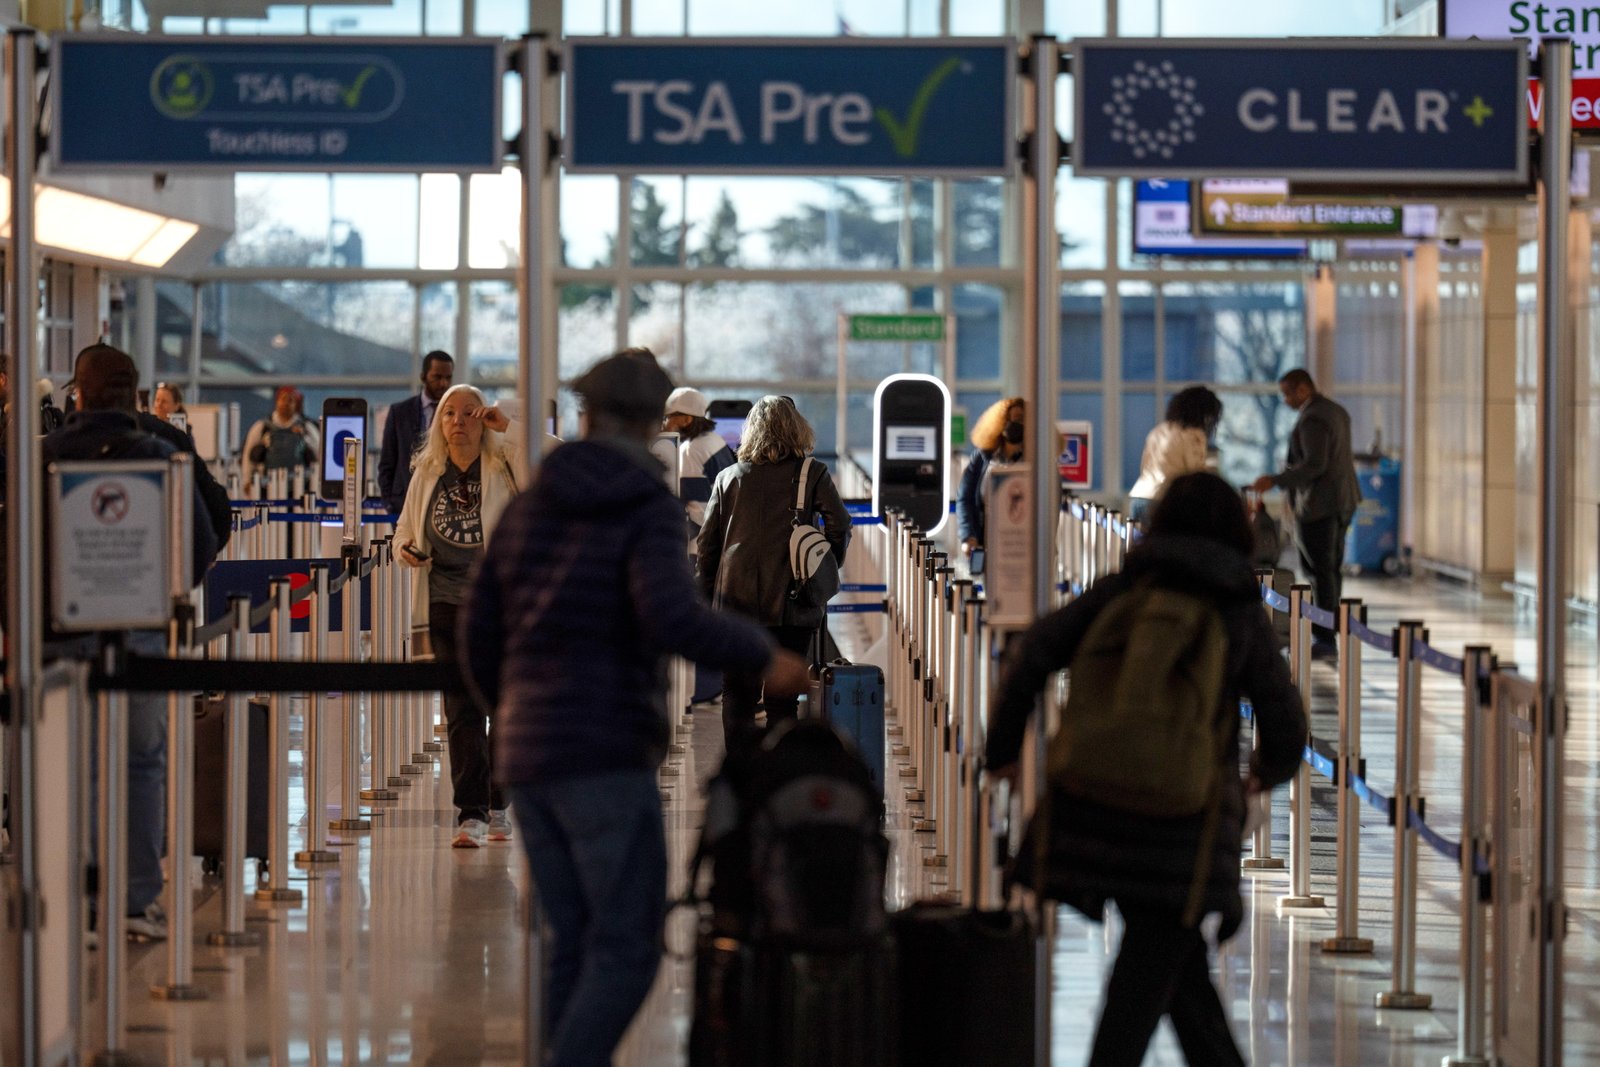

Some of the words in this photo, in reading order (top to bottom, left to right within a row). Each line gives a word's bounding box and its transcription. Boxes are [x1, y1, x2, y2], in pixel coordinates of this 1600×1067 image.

[234, 72, 288, 105] TSA
[292, 72, 342, 106] Pre
[611, 80, 745, 145] TSA
[759, 81, 874, 146] Pre
[206, 127, 316, 154] Touchless
[319, 129, 348, 155] ID
[1232, 203, 1313, 222] Standard
[1315, 204, 1395, 224] Entrance
[856, 318, 938, 337] Standard
